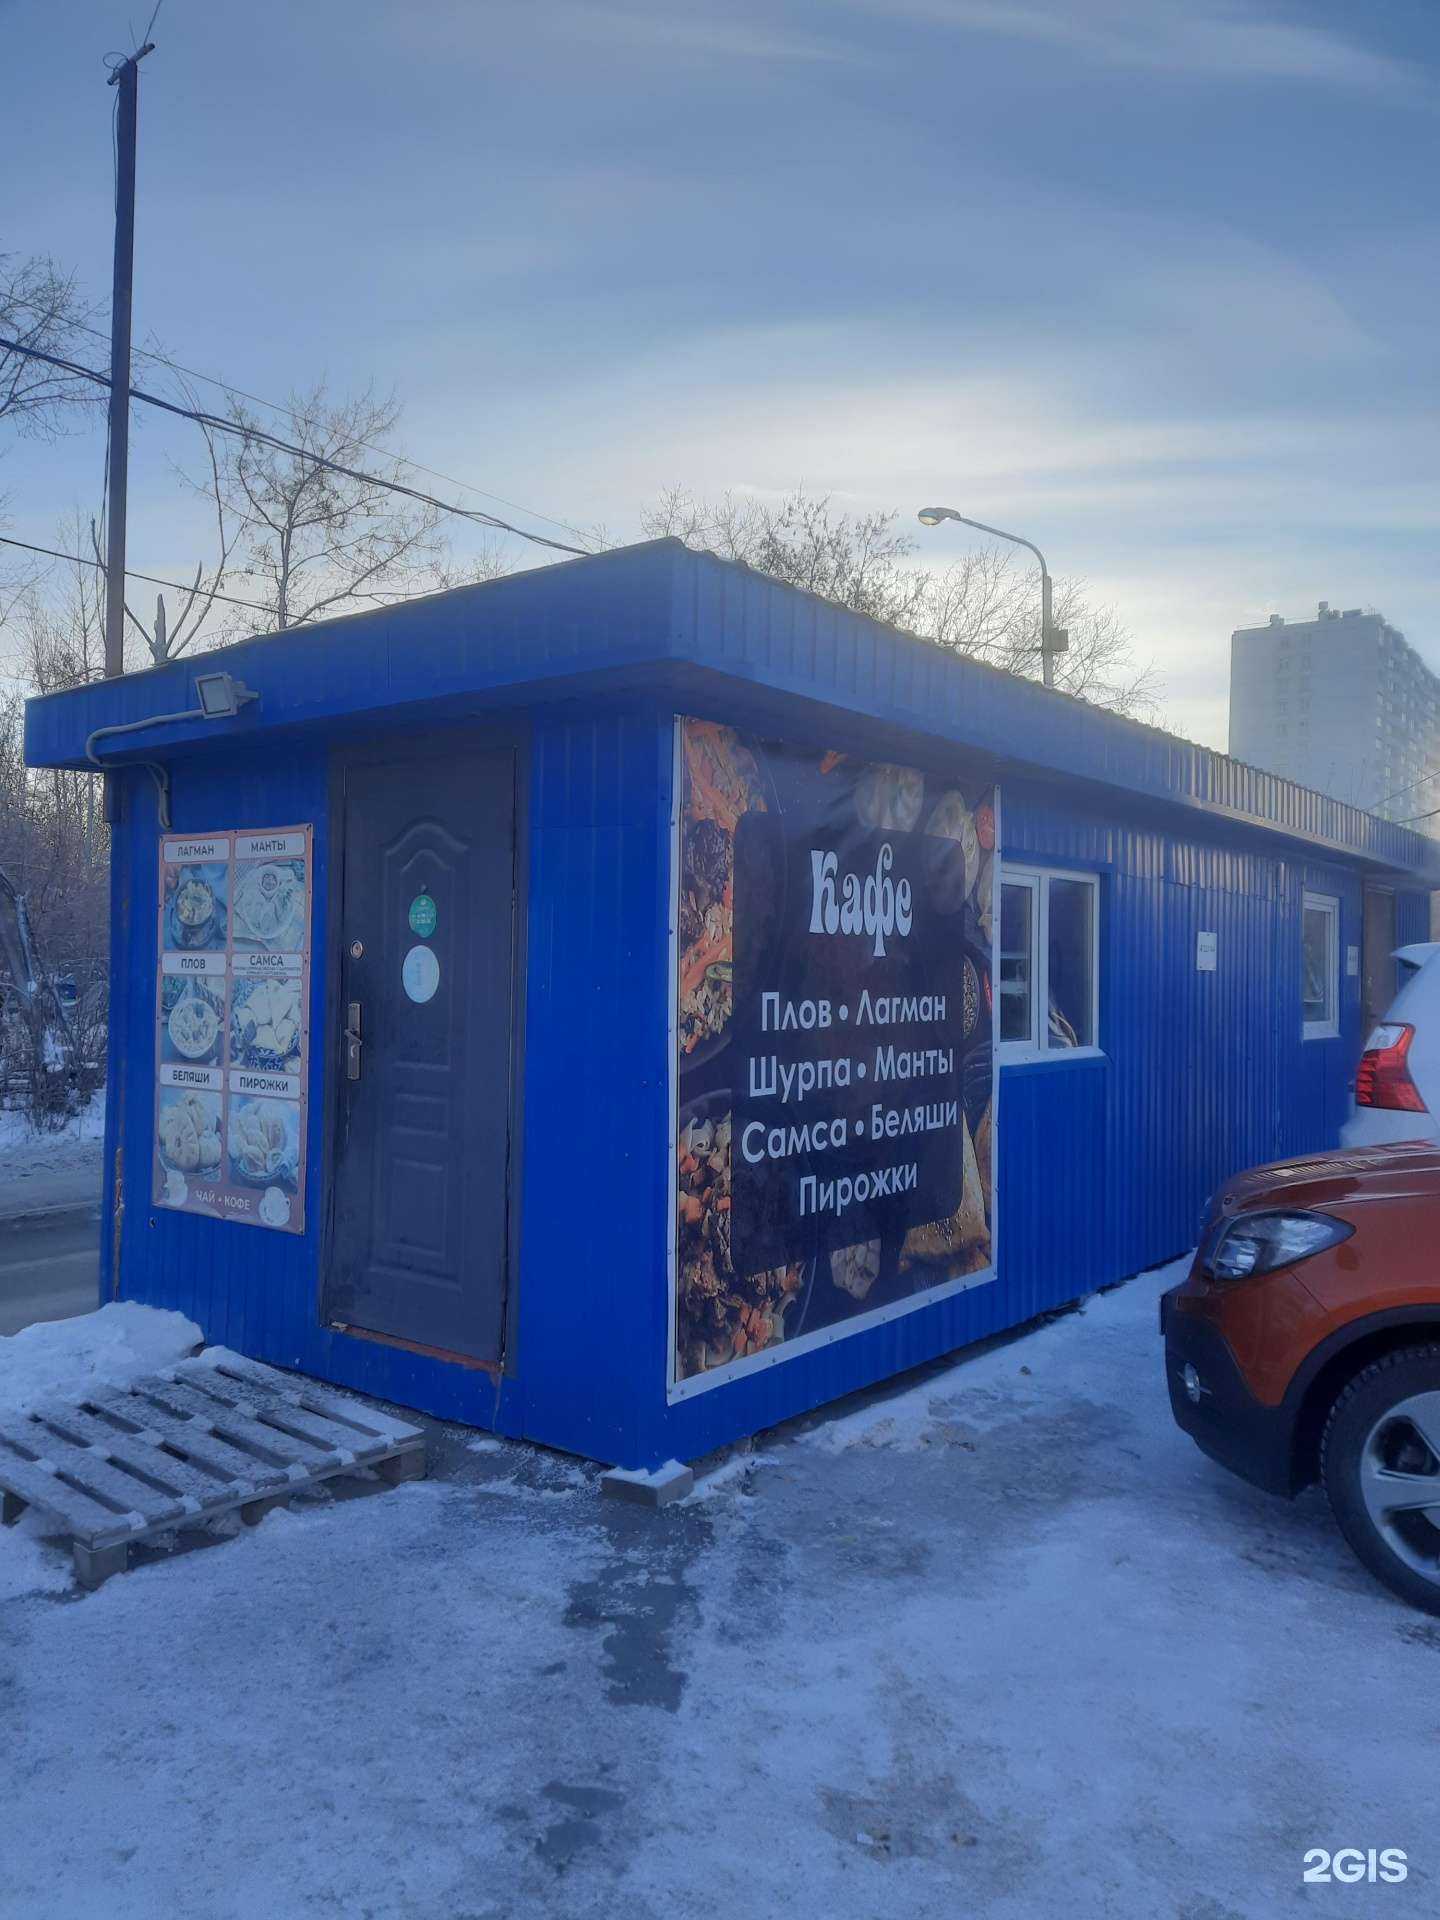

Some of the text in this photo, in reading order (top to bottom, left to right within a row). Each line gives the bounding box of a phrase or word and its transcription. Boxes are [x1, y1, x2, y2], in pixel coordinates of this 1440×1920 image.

[177, 844, 215, 857] ЛАГМАН
[251, 840, 286, 852] МАНТЫ
[809, 842, 913, 957] Кафе
[181, 958, 206, 969] ПЛОВ
[250, 955, 284, 967] САМСА
[761, 989, 946, 1031] Плов Лагман
[172, 1070, 210, 1084] БЕЛЯШИ
[750, 1045, 953, 1103] Шурпа Манты
[239, 1076, 289, 1092] ПИРОЖКИ
[741, 1101, 957, 1163] Самса Беляши
[800, 1162, 917, 1217] Пирожки
[224, 1195, 251, 1210] КОФЕ
